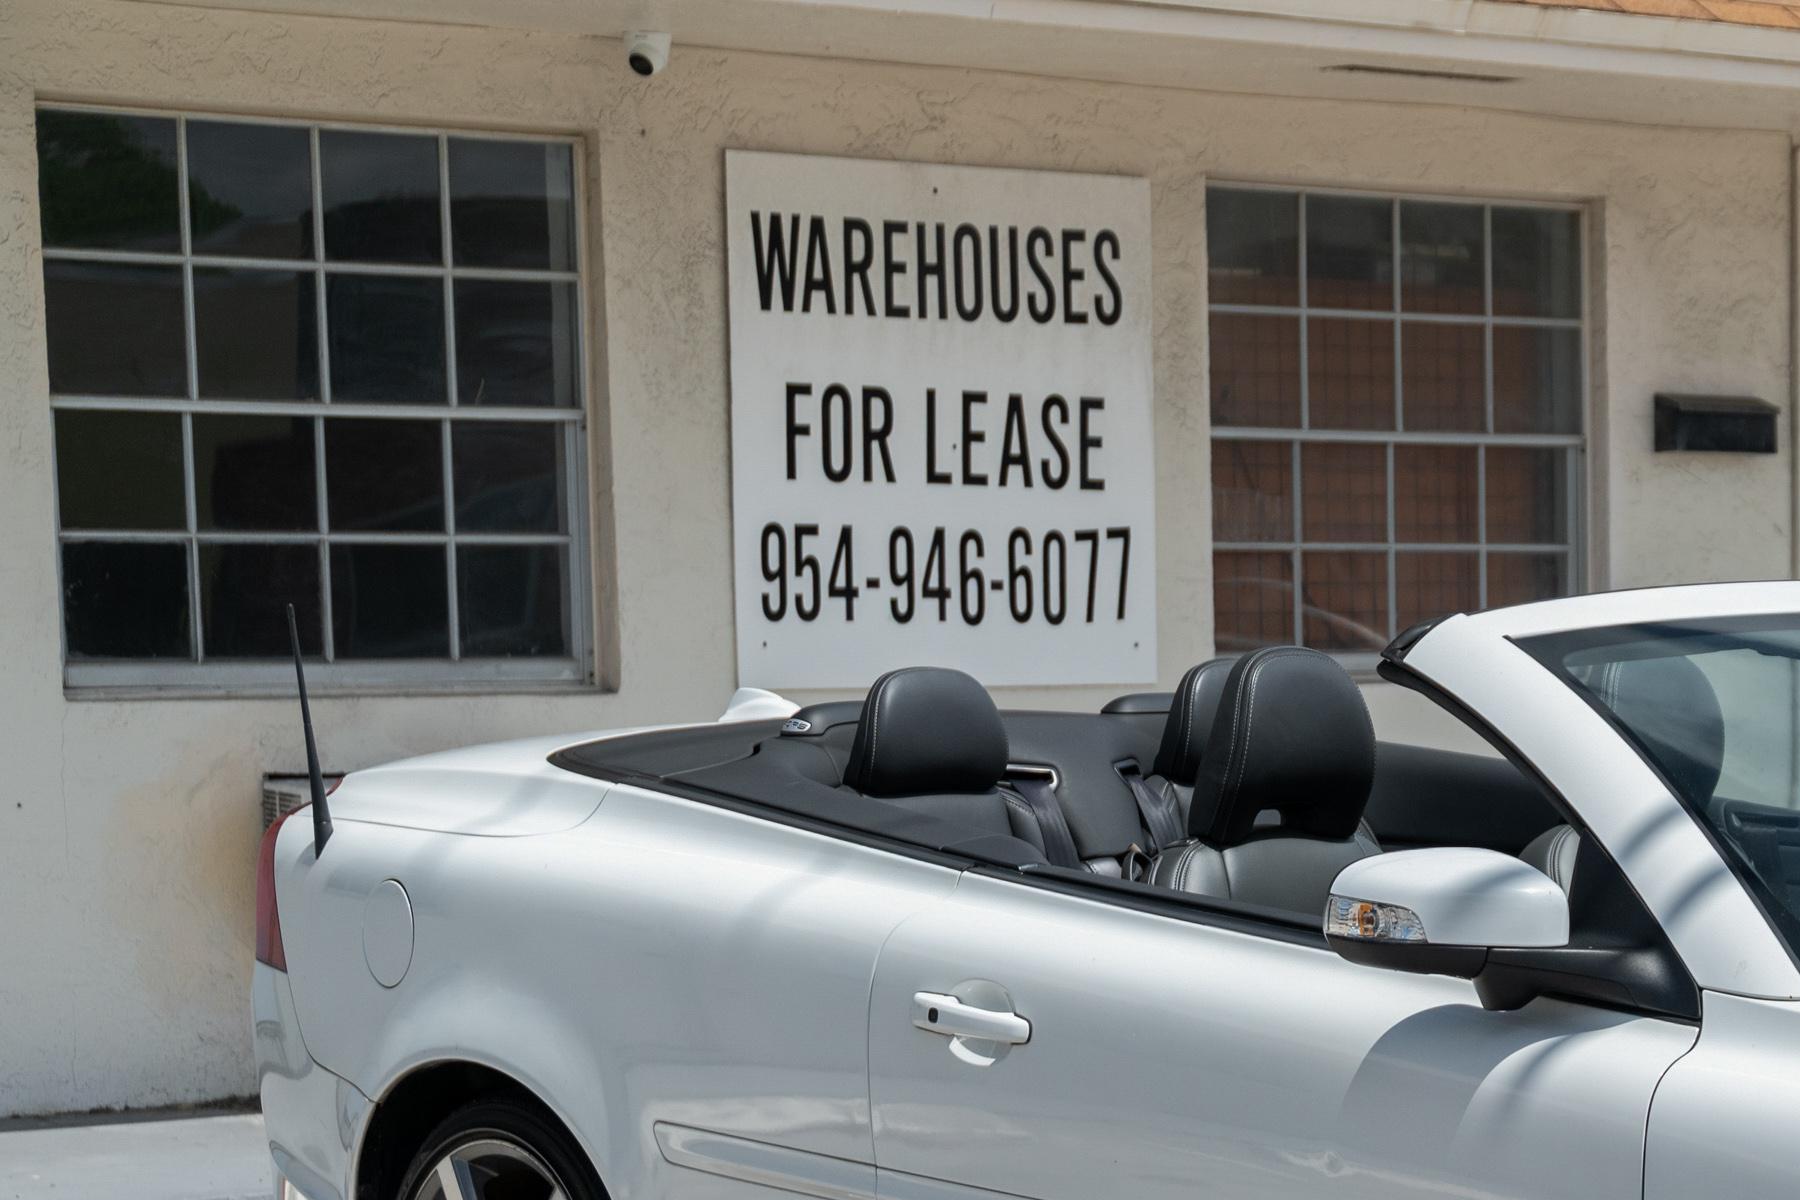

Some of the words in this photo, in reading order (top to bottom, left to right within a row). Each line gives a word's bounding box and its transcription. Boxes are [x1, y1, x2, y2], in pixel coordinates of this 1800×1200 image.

[751, 211, 1122, 326] WAREHOUSES
[786, 383, 896, 482] FOR
[927, 389, 1104, 490] LEASE
[761, 523, 1130, 626] 954-946-6077
